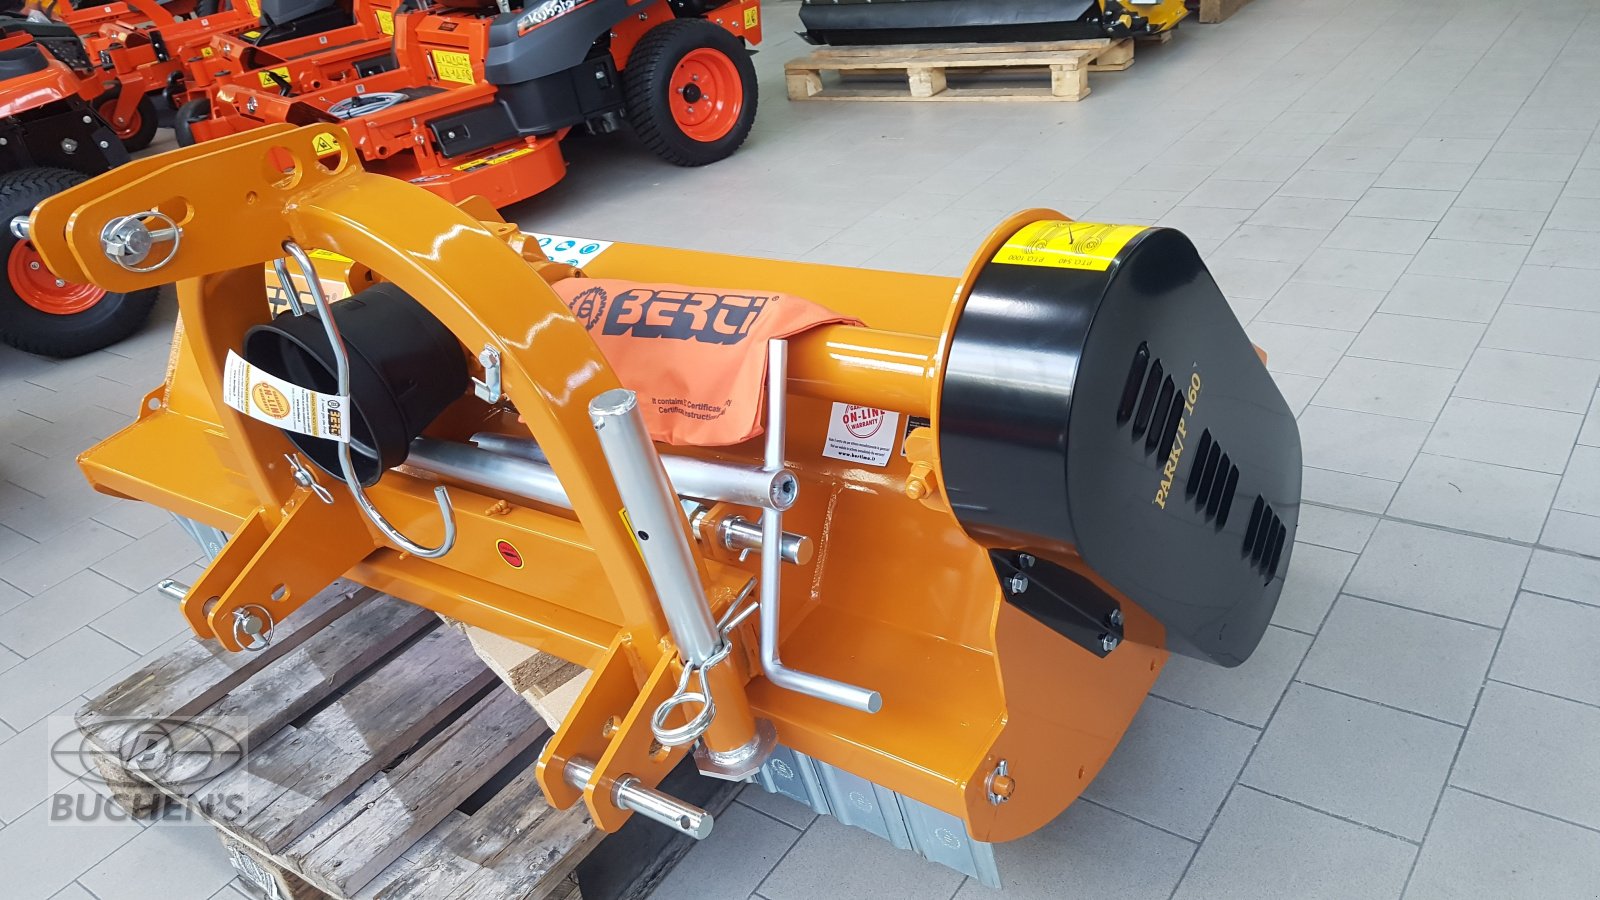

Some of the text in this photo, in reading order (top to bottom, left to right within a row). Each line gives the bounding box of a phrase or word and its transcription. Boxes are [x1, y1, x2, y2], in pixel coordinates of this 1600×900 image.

[261, 382, 282, 419] ON-LINE
[851, 417, 878, 430] WARRANTY
[1154, 372, 1201, 510] PARK/P 160
